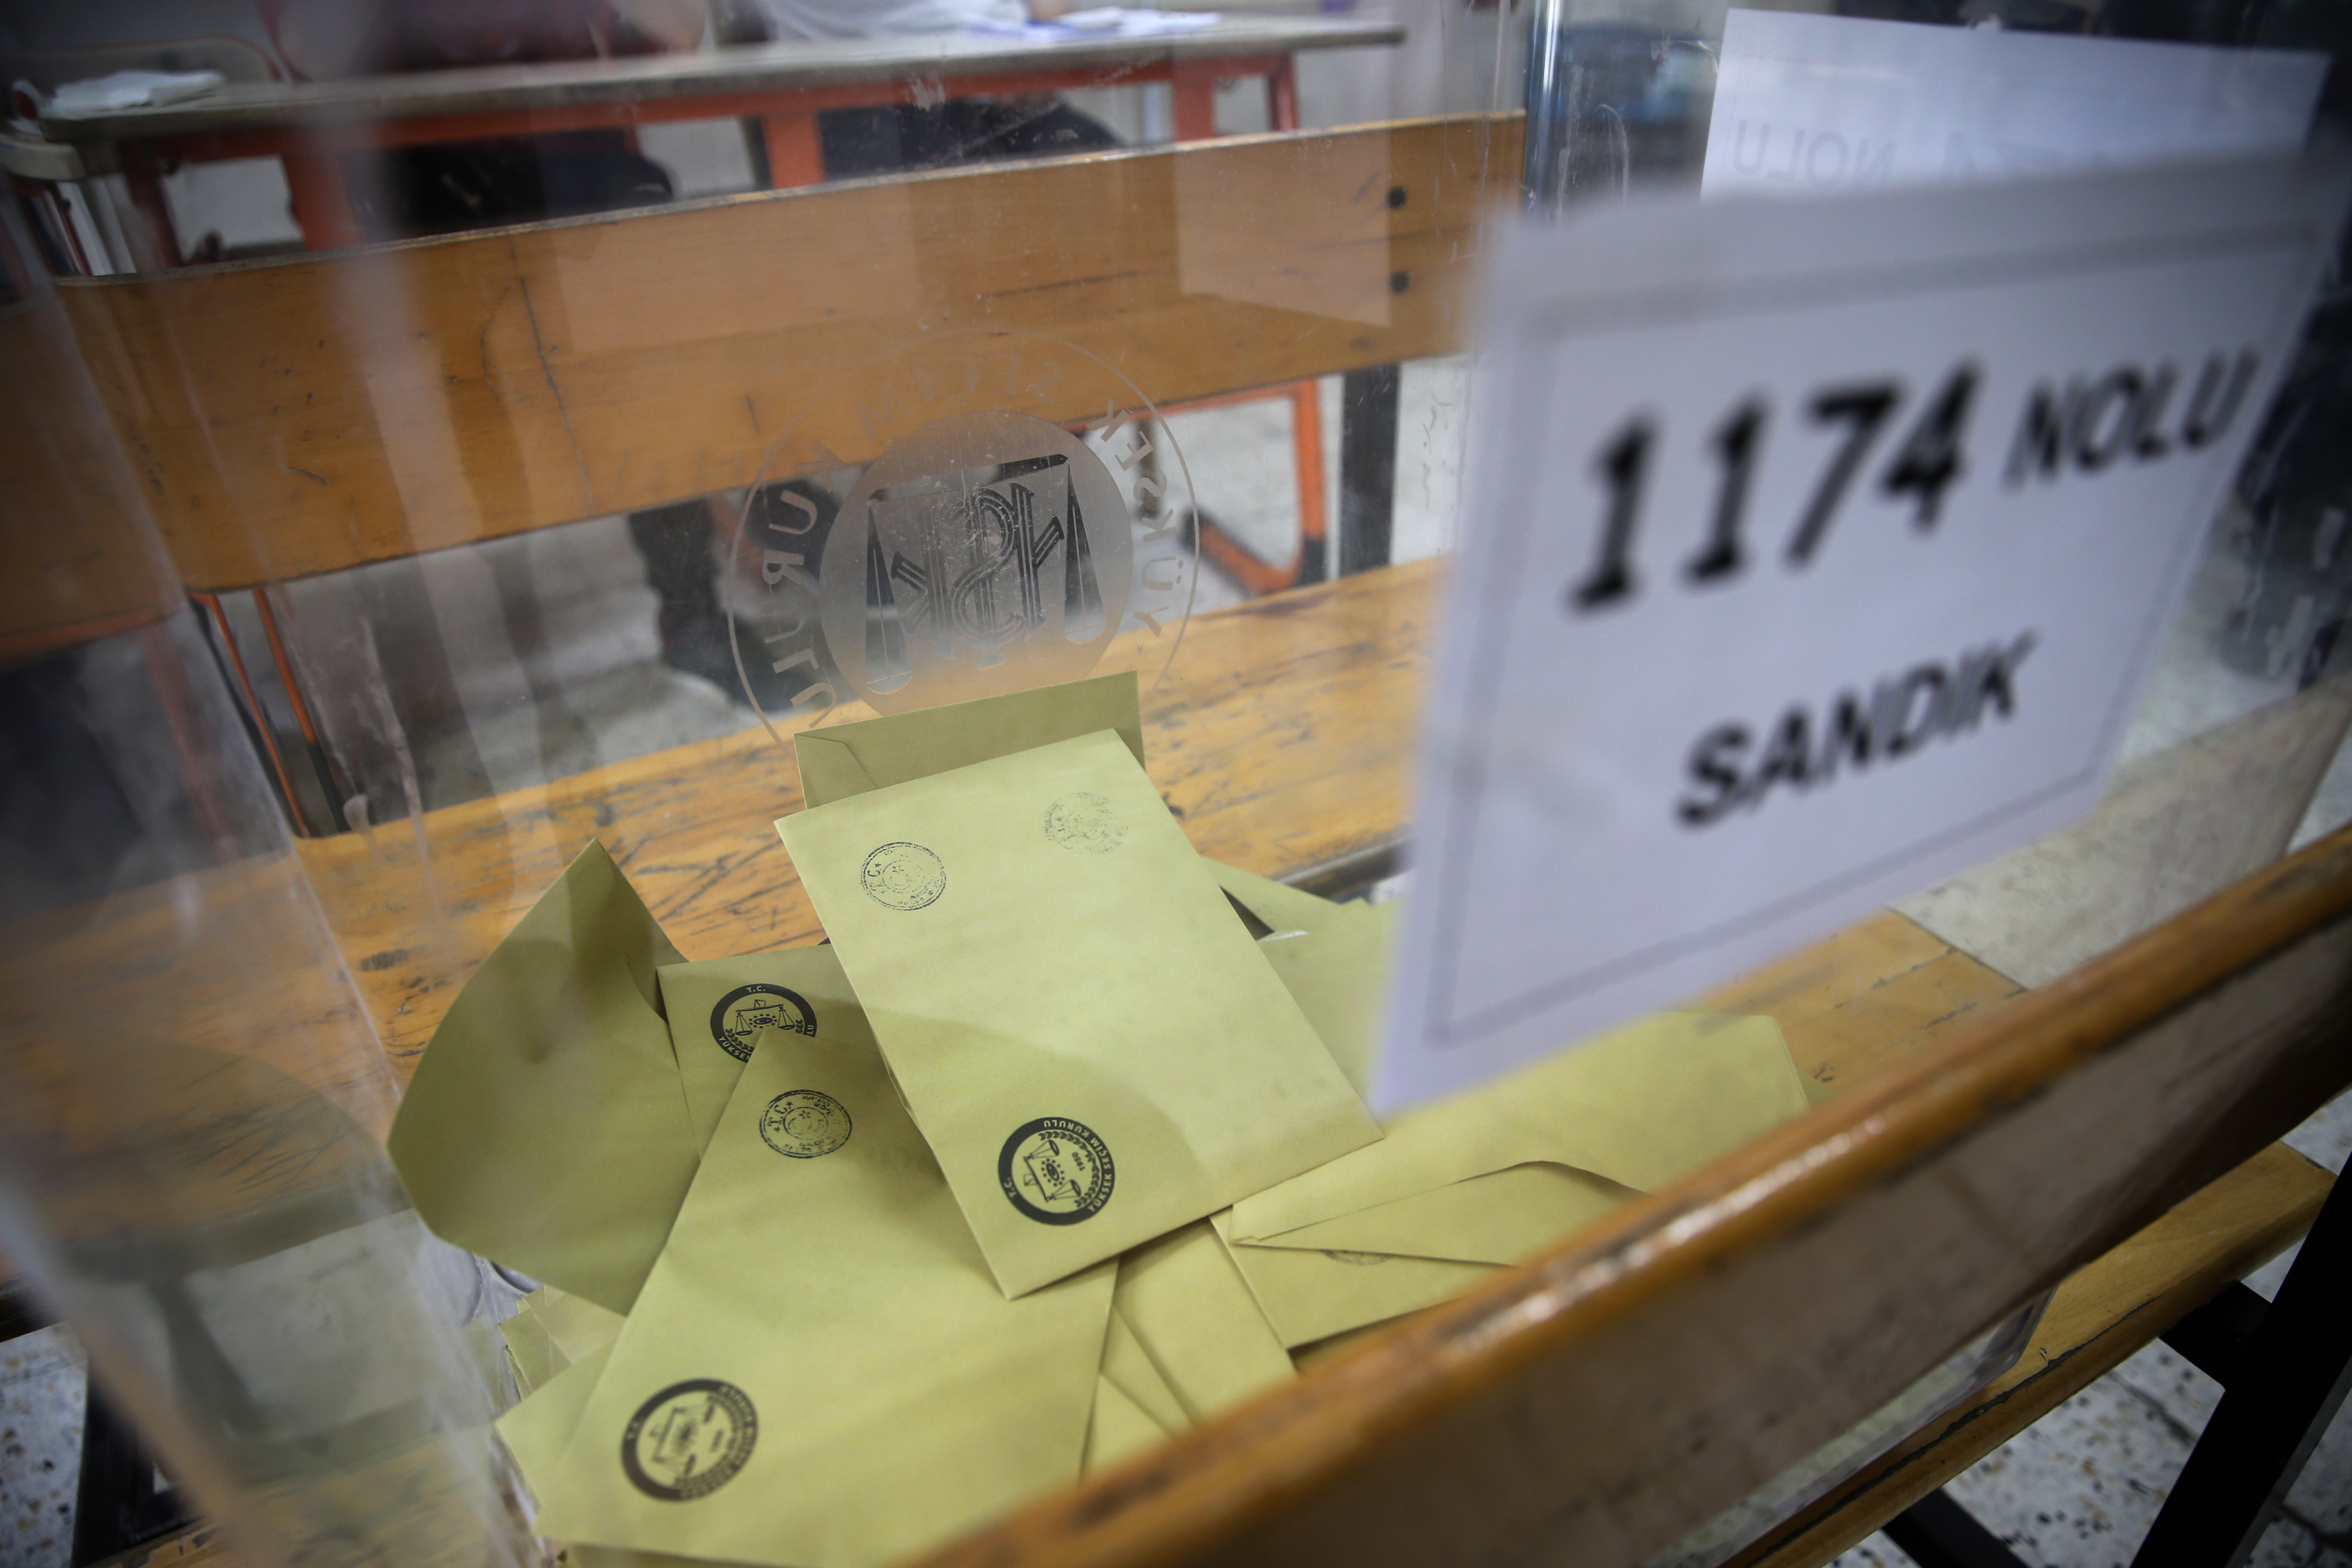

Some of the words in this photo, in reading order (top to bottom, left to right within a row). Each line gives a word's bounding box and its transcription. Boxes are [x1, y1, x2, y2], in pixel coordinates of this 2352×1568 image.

[1568, 355, 1985, 617] 1174
[2003, 349, 2259, 489] NOLU
[1678, 633, 2039, 827] SANDIK
[1044, 1119, 1090, 1138] KURULU
[1072, 1152, 1085, 1171] 1950
[1088, 1173, 1112, 1212] YÜKSEK
